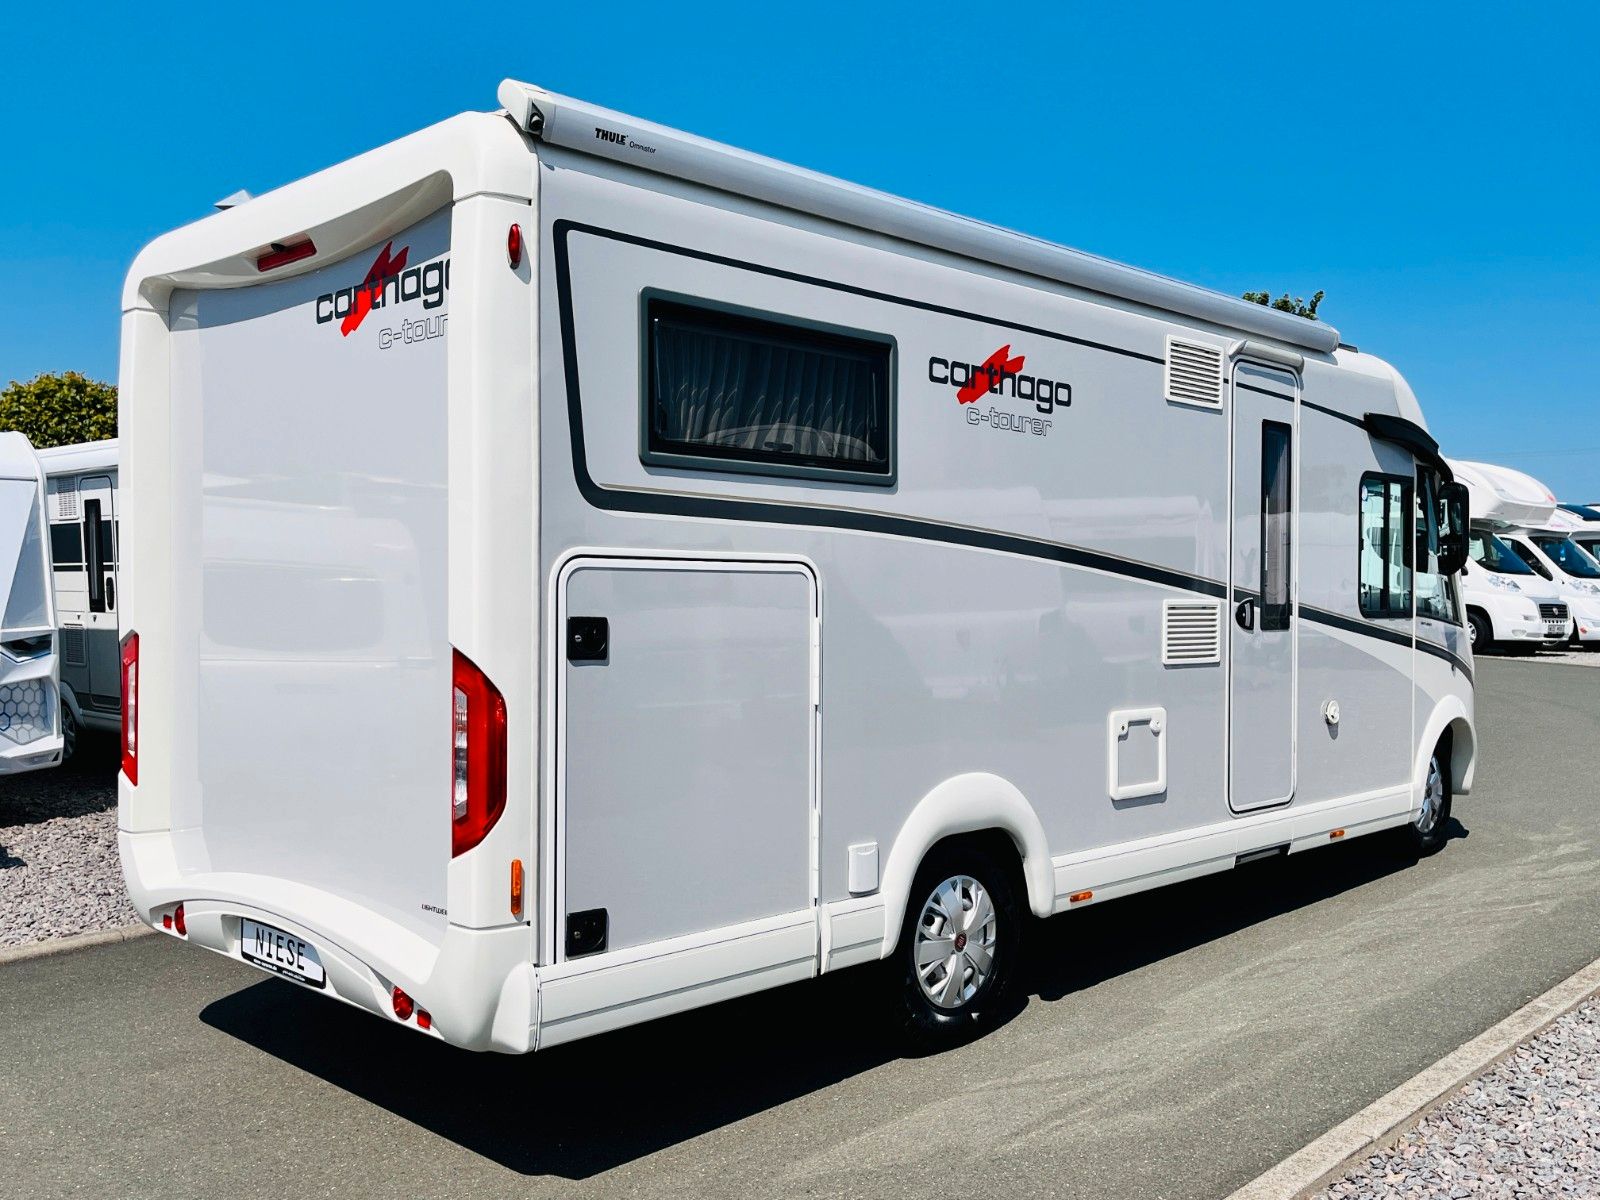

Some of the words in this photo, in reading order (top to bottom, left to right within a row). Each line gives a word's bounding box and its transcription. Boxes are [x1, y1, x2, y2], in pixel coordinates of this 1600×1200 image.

[595, 128, 626, 146] THULE
[629, 141, 656, 154] Omnistor
[929, 356, 1072, 415] carthago
[966, 407, 1052, 436] c-tourer
[255, 927, 306, 971] NIESE
